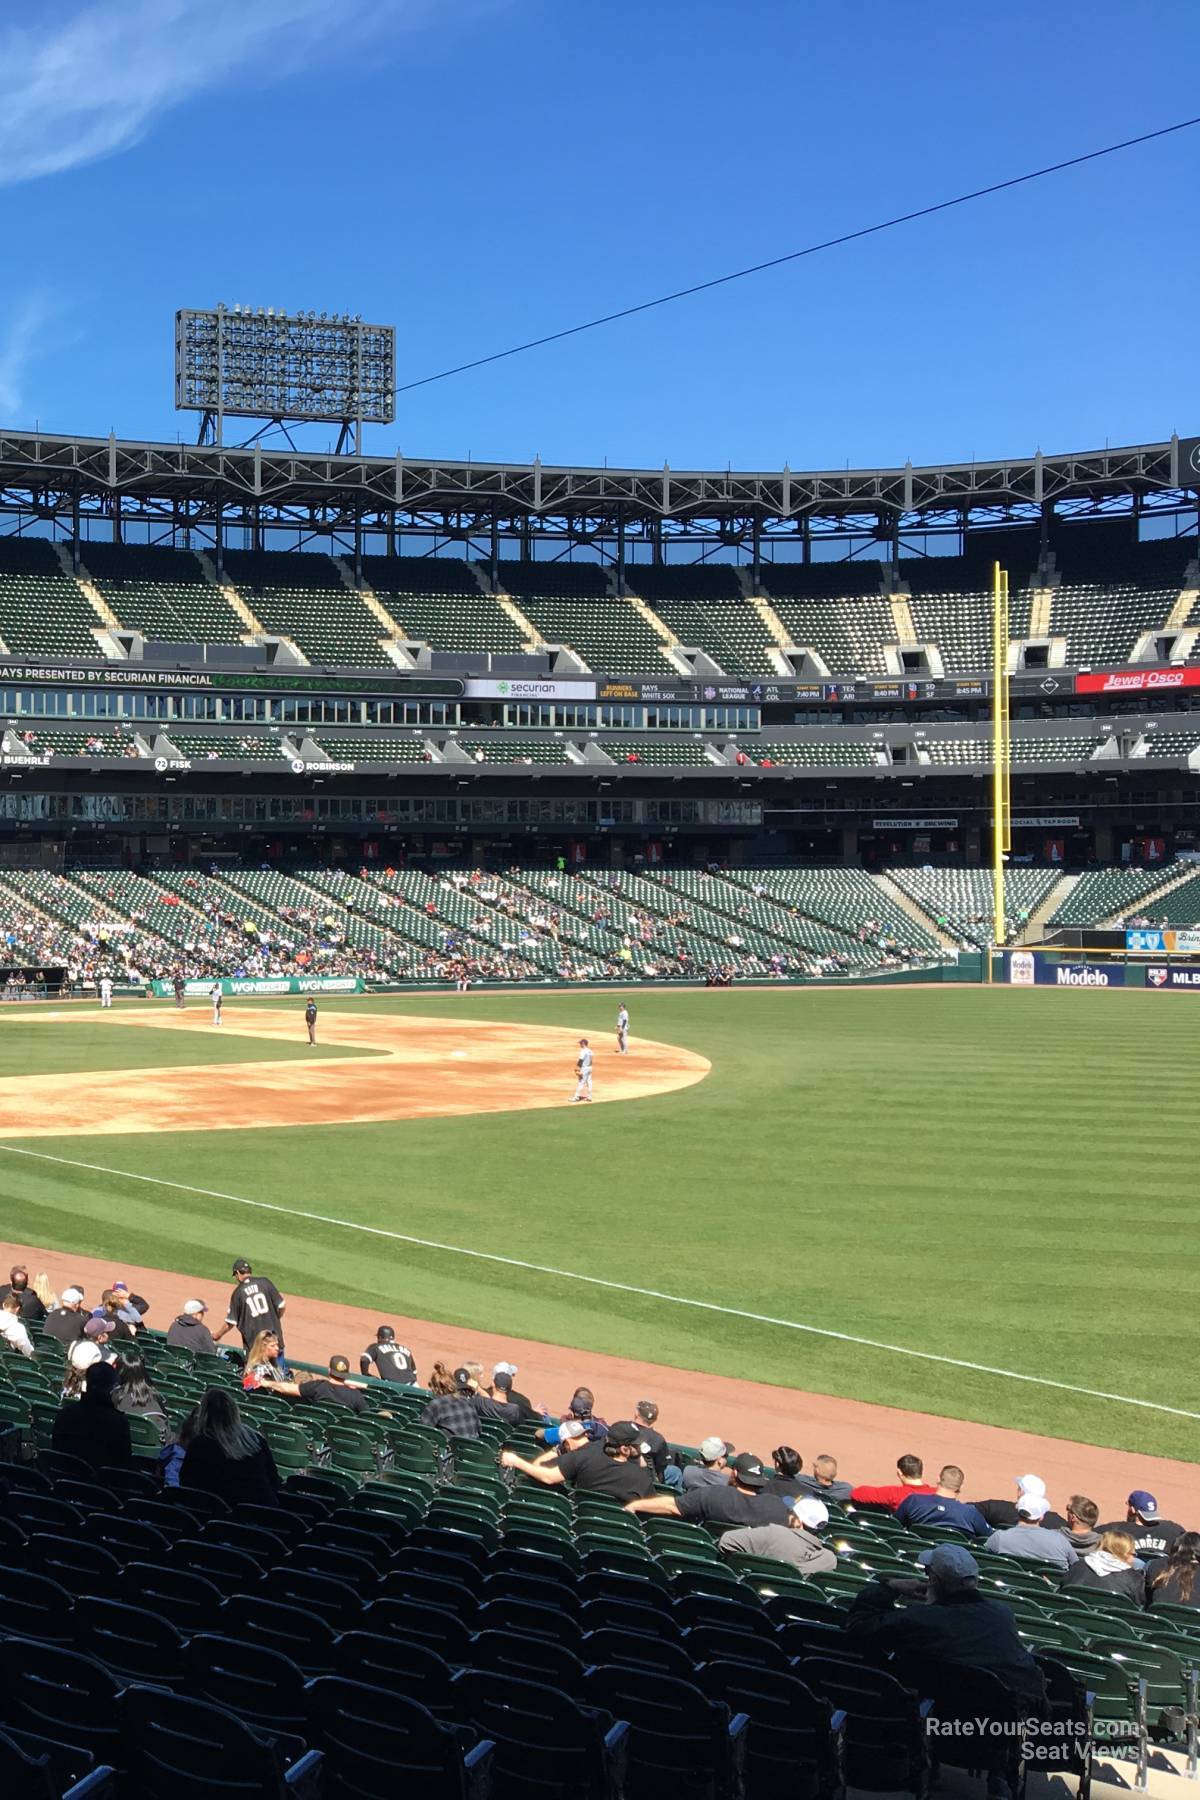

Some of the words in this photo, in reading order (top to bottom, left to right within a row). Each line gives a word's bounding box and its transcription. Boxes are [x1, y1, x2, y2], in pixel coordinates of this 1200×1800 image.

[25, 668, 86, 680] PRESENTED
[88, 671, 102, 681] BY
[104, 672, 156, 683] SECURIAN
[159, 674, 212, 685] FINANCIAL
[1108, 672, 1184, 686] Jewel-Osco
[511, 683, 555, 693] securian
[3, 756, 50, 765] BUEHRLE
[170, 760, 191, 769] FISK
[306, 762, 354, 771] ROBINSON
[1057, 967, 1108, 986] Modelo
[231, 982, 257, 992] WGN
[299, 980, 323, 990] WGN
[246, 1293, 269, 1318] 10
[393, 1352, 408, 1370] 0
